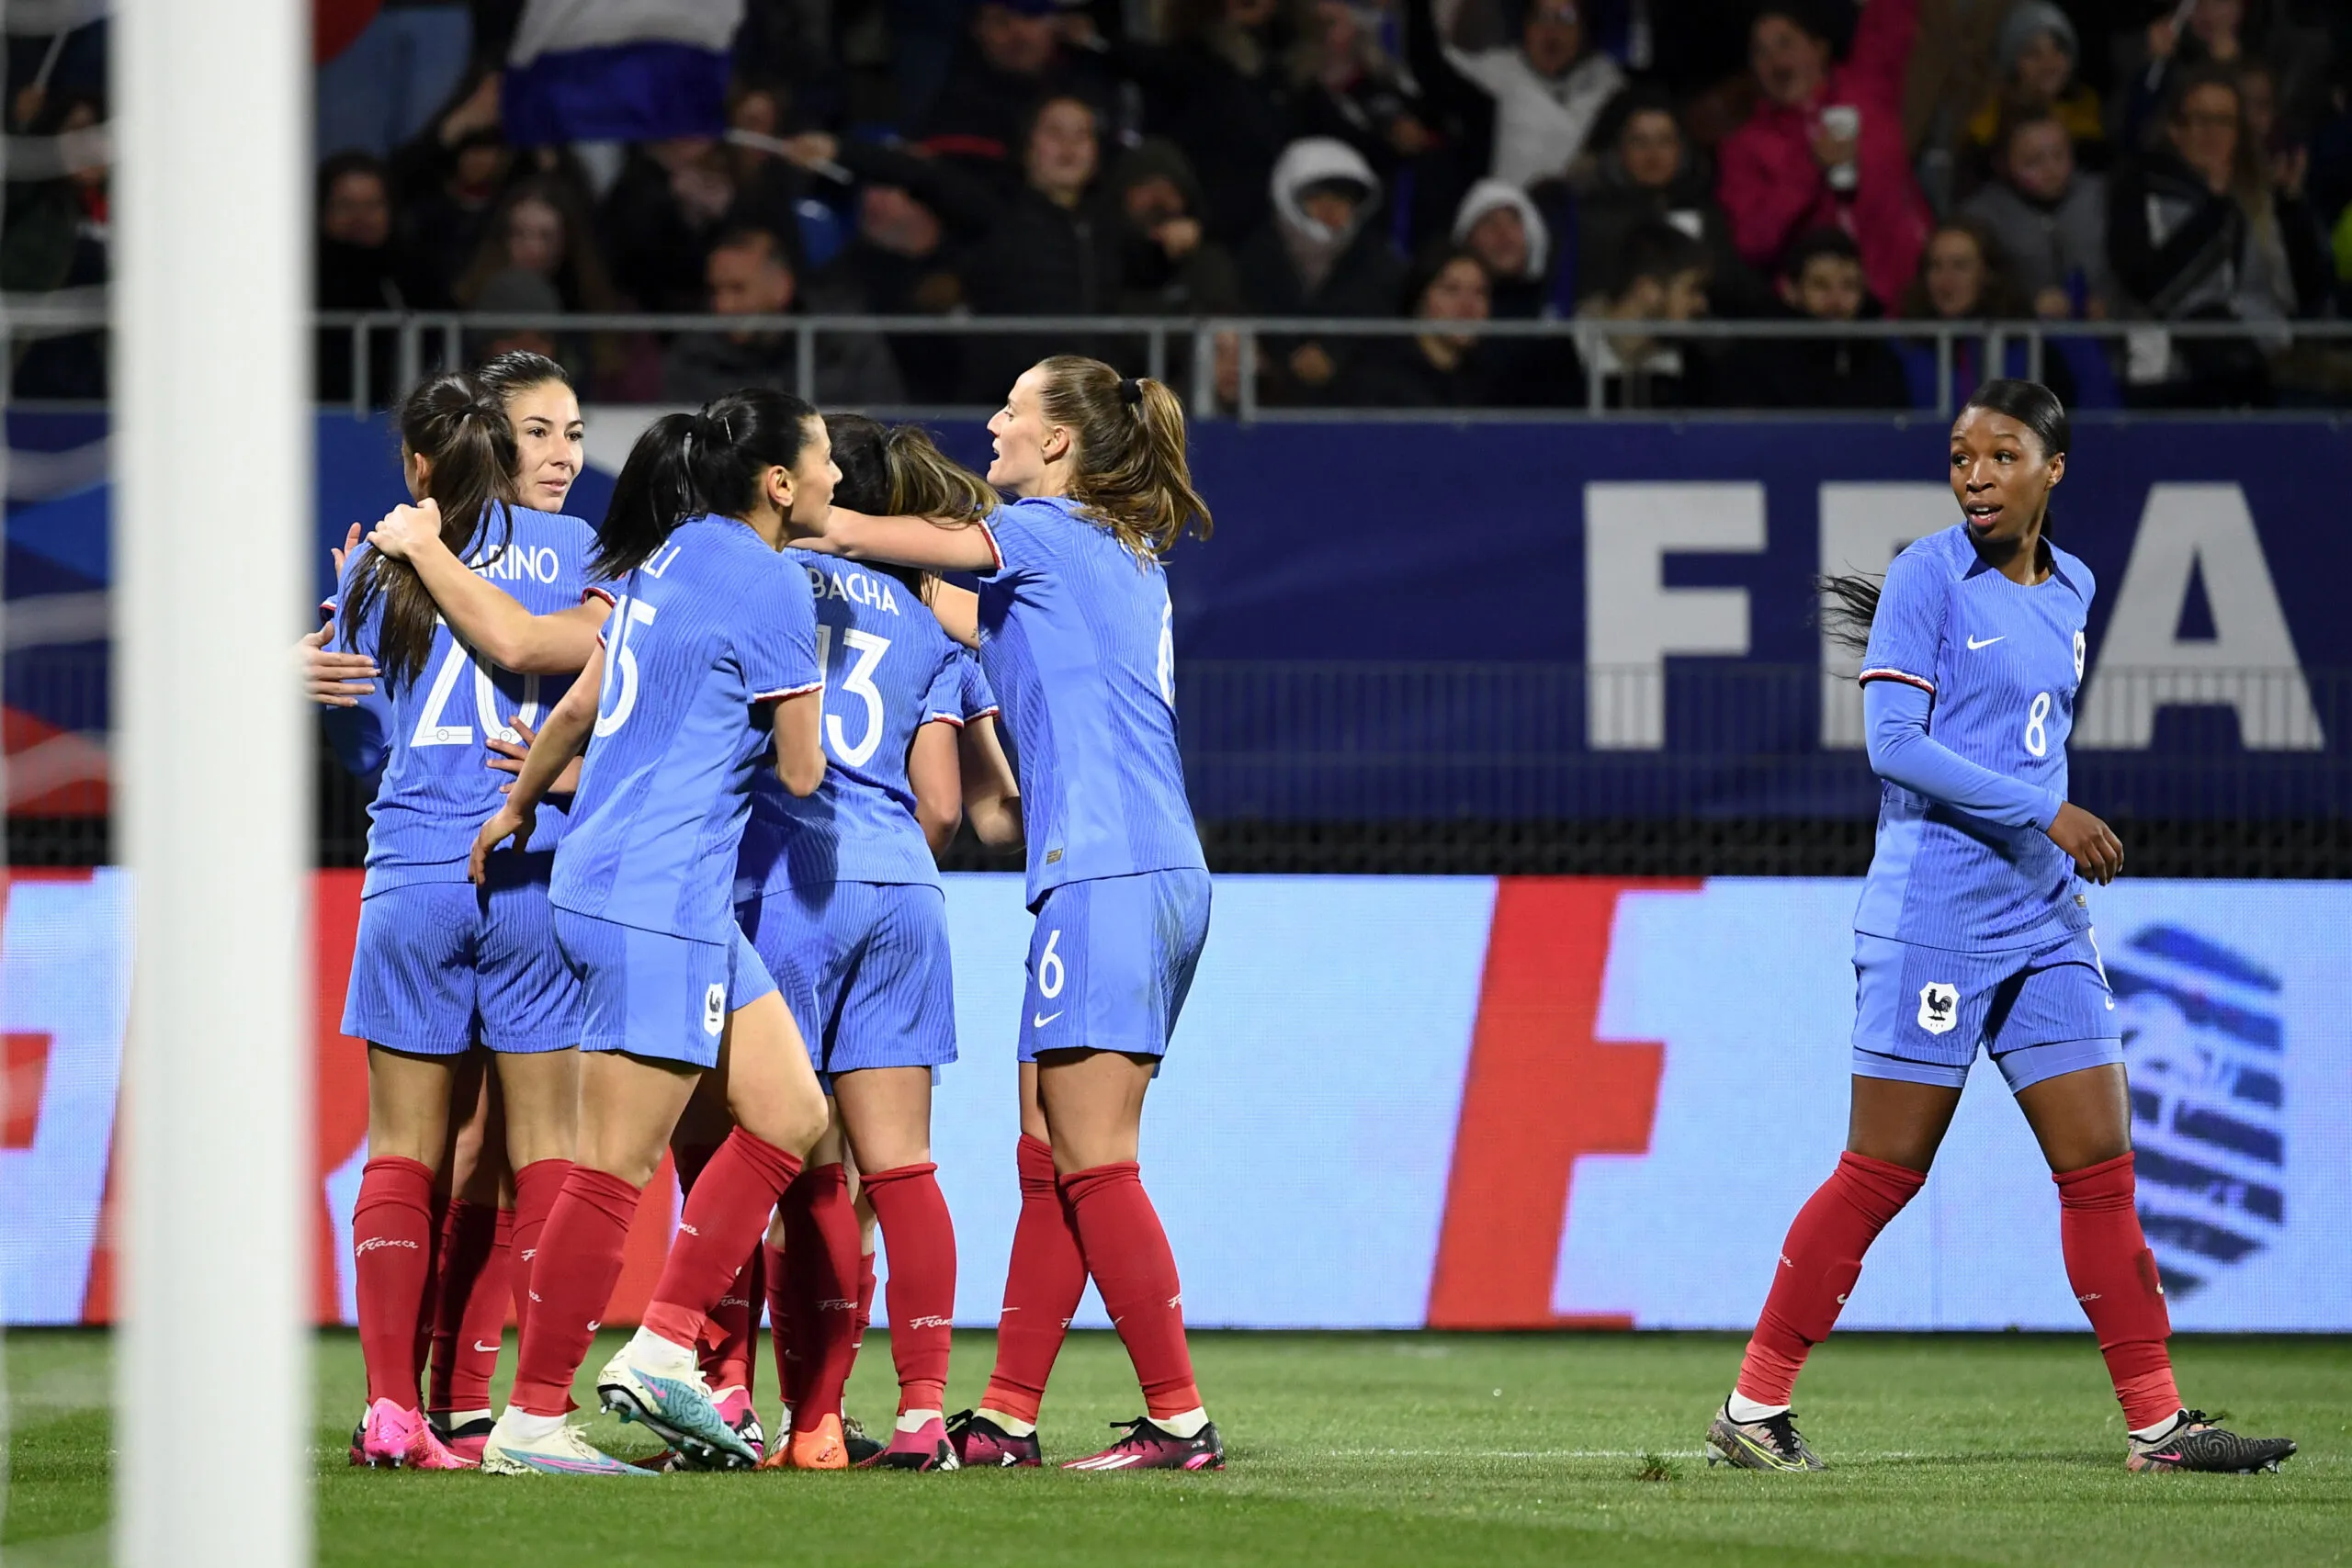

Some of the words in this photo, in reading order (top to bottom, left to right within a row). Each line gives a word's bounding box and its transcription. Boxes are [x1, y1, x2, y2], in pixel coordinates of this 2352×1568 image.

[469, 544, 560, 584] ARINO
[808, 567, 900, 615] BACHA
[816, 624, 892, 768] 13
[2025, 691, 2051, 757] 8
[1039, 929, 1065, 999] 6
[356, 1235, 419, 1258] France
[909, 1314, 955, 1330] Fran
